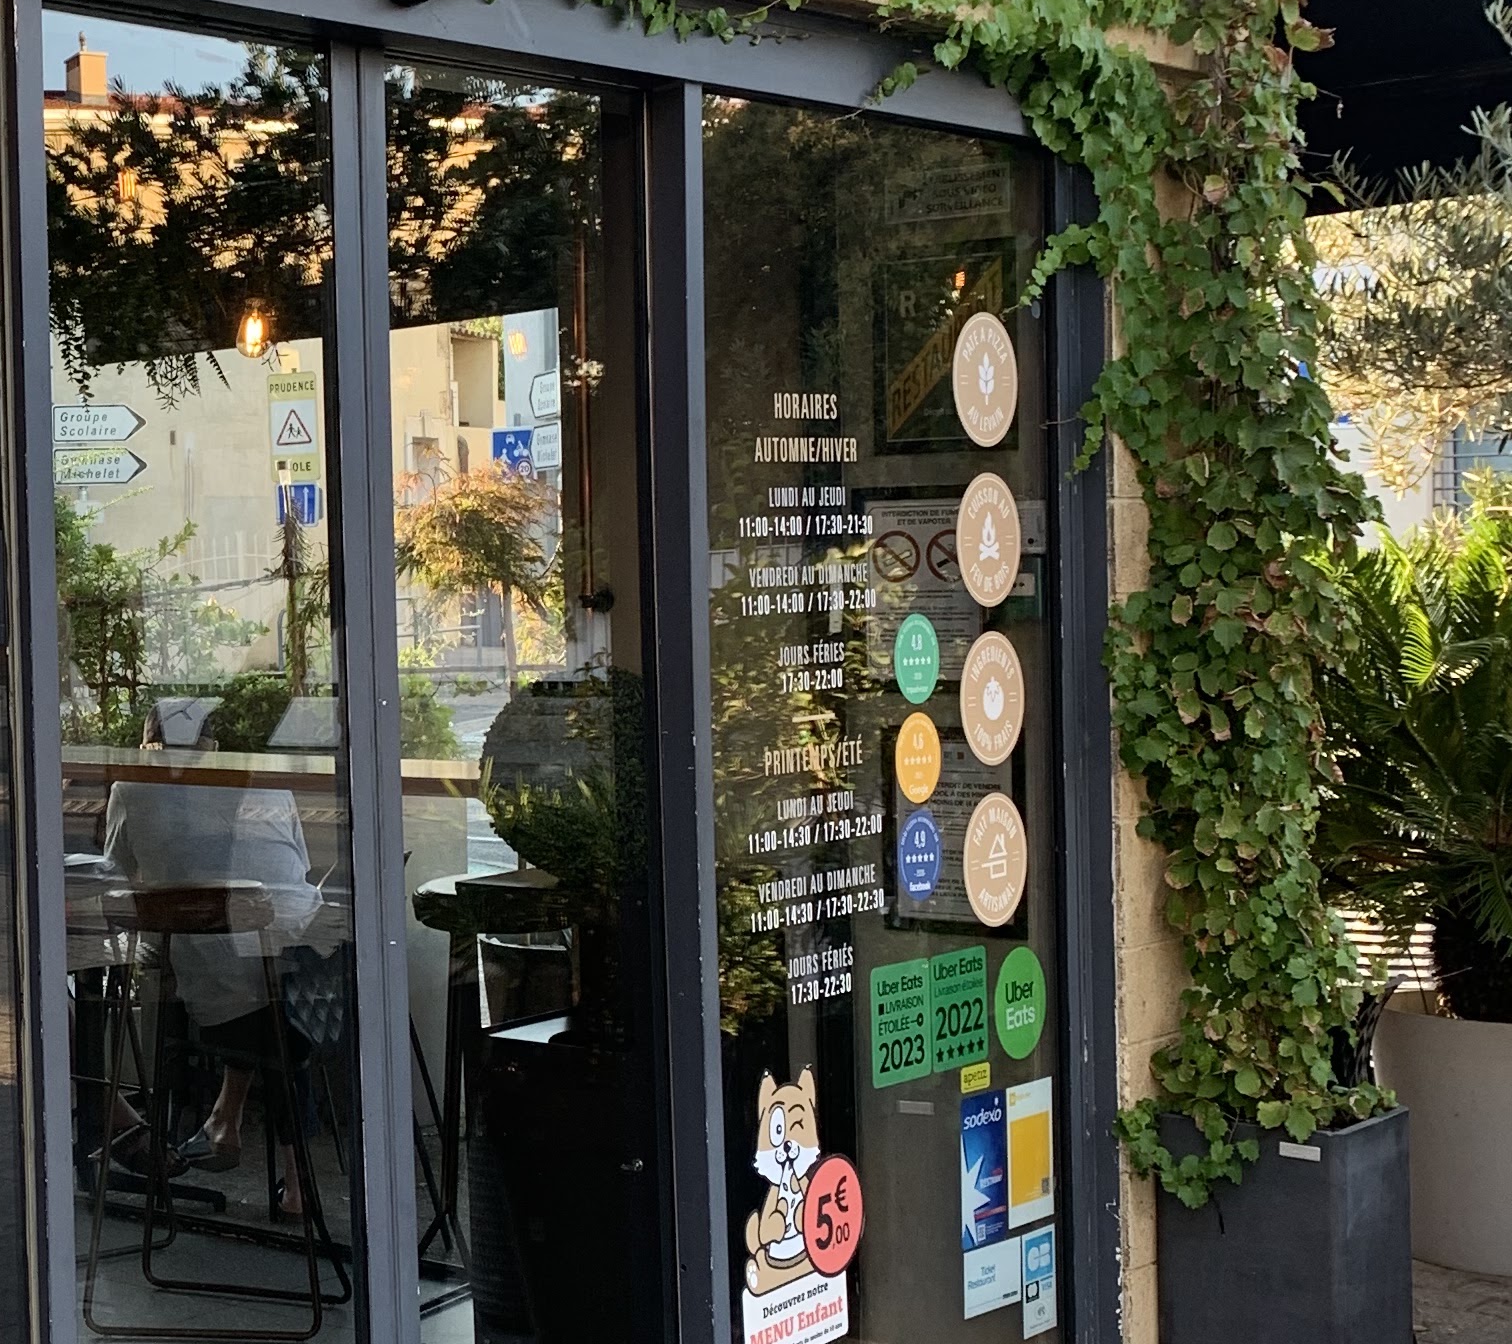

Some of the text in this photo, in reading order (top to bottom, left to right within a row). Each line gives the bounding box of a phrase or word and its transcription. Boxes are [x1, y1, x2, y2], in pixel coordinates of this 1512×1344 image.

[987, 328, 1008, 365] PIZZA
[270, 380, 315, 394] PRUDENCE
[60, 412, 108, 424] Groupe
[774, 392, 838, 420] HORAIRES
[967, 405, 980, 425] AU
[60, 425, 117, 437] Scolaire
[754, 437, 858, 463] AUTOMNE/HIVER
[769, 486, 846, 508] LUNDI AU JEUDI
[998, 498, 1010, 519] AU
[739, 515, 803, 538] 11:00-14:00
[815, 514, 873, 535] 17:30-21:30
[749, 563, 868, 588] VENDREDI AU DIMANCHE
[741, 593, 805, 616] 11:00-14:00
[817, 588, 877, 612] 17:30-22:00
[778, 644, 810, 667] JOURS
[782, 668, 843, 693] 17:30-22:00
[993, 719, 1014, 752] FRAIS
[764, 733, 864, 777] PRINTEMPS/ÉTÉ
[777, 790, 854, 821] LUNDI AU JEUDI
[748, 825, 811, 855] 11:00-14:30
[823, 814, 883, 843] 17:30-22:00
[973, 814, 988, 848] FAIT
[988, 807, 1017, 840] MAISON
[757, 863, 876, 904] VENDREDI AU DIMANCHE
[977, 881, 1016, 913] ARTISANAL
[751, 901, 813, 933] 11:00-14:30
[826, 888, 885, 919] 17:30-22:30
[787, 942, 854, 980] JOURS FÉRIÉS
[933, 956, 984, 982] Uber Eats
[791, 972, 853, 1005] 17:30-22:30
[877, 975, 924, 997] Uber Eats
[1005, 980, 1034, 1005] Uber
[885, 995, 924, 1015] LIVRAISON
[1005, 1004, 1036, 1031] Eats
[878, 1015, 911, 1037] ÉTOILÉE
[935, 997, 985, 1042] 2022
[878, 1033, 926, 1074] 2023
[963, 1068, 988, 1086] apetiz
[963, 1107, 1003, 1131] sodexo
[762, 1281, 829, 1320] Découvrez notre
[797, 1294, 844, 1332] Enfant
